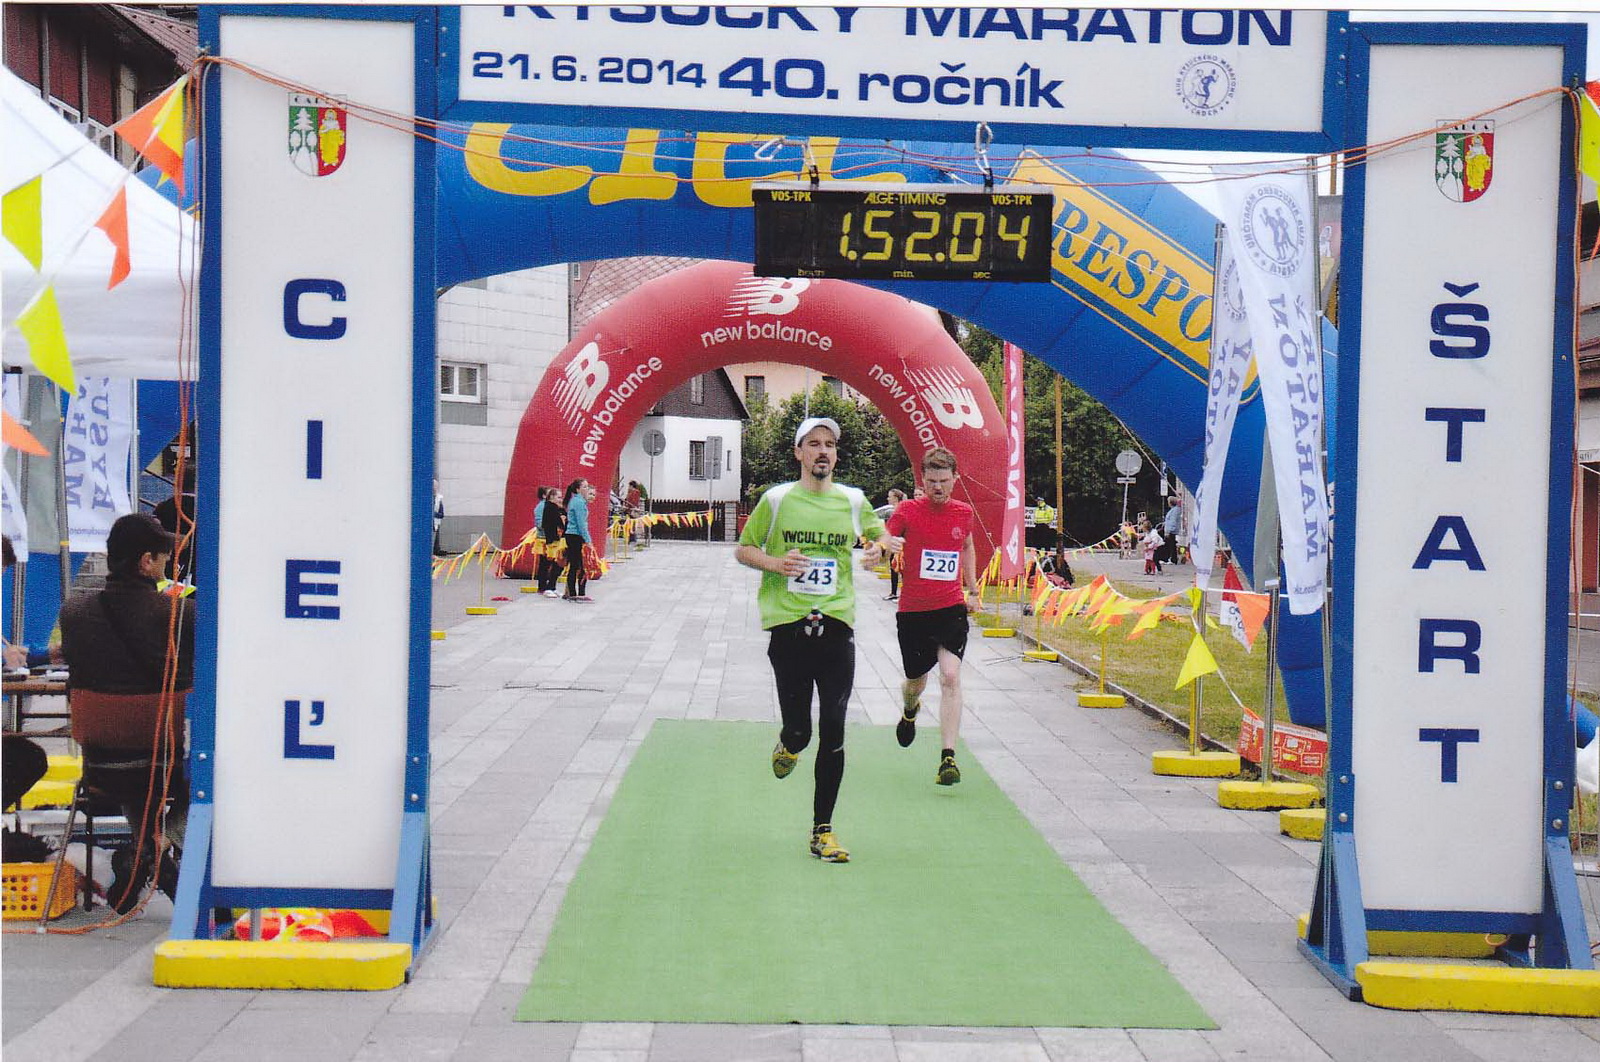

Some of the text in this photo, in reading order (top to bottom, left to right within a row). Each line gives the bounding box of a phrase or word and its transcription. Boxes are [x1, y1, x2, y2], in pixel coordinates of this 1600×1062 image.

[599, 57, 707, 88] 2014
[718, 56, 839, 99] 40.
[858, 61, 1065, 108] ročník
[839, 210, 1031, 262] 1.52.04
[1051, 198, 1213, 342] RESPO
[701, 320, 833, 351] new balance
[579, 355, 663, 468] new balance
[867, 363, 940, 451] new balan
[794, 568, 832, 585] 243
[925, 558, 956, 573] 220
